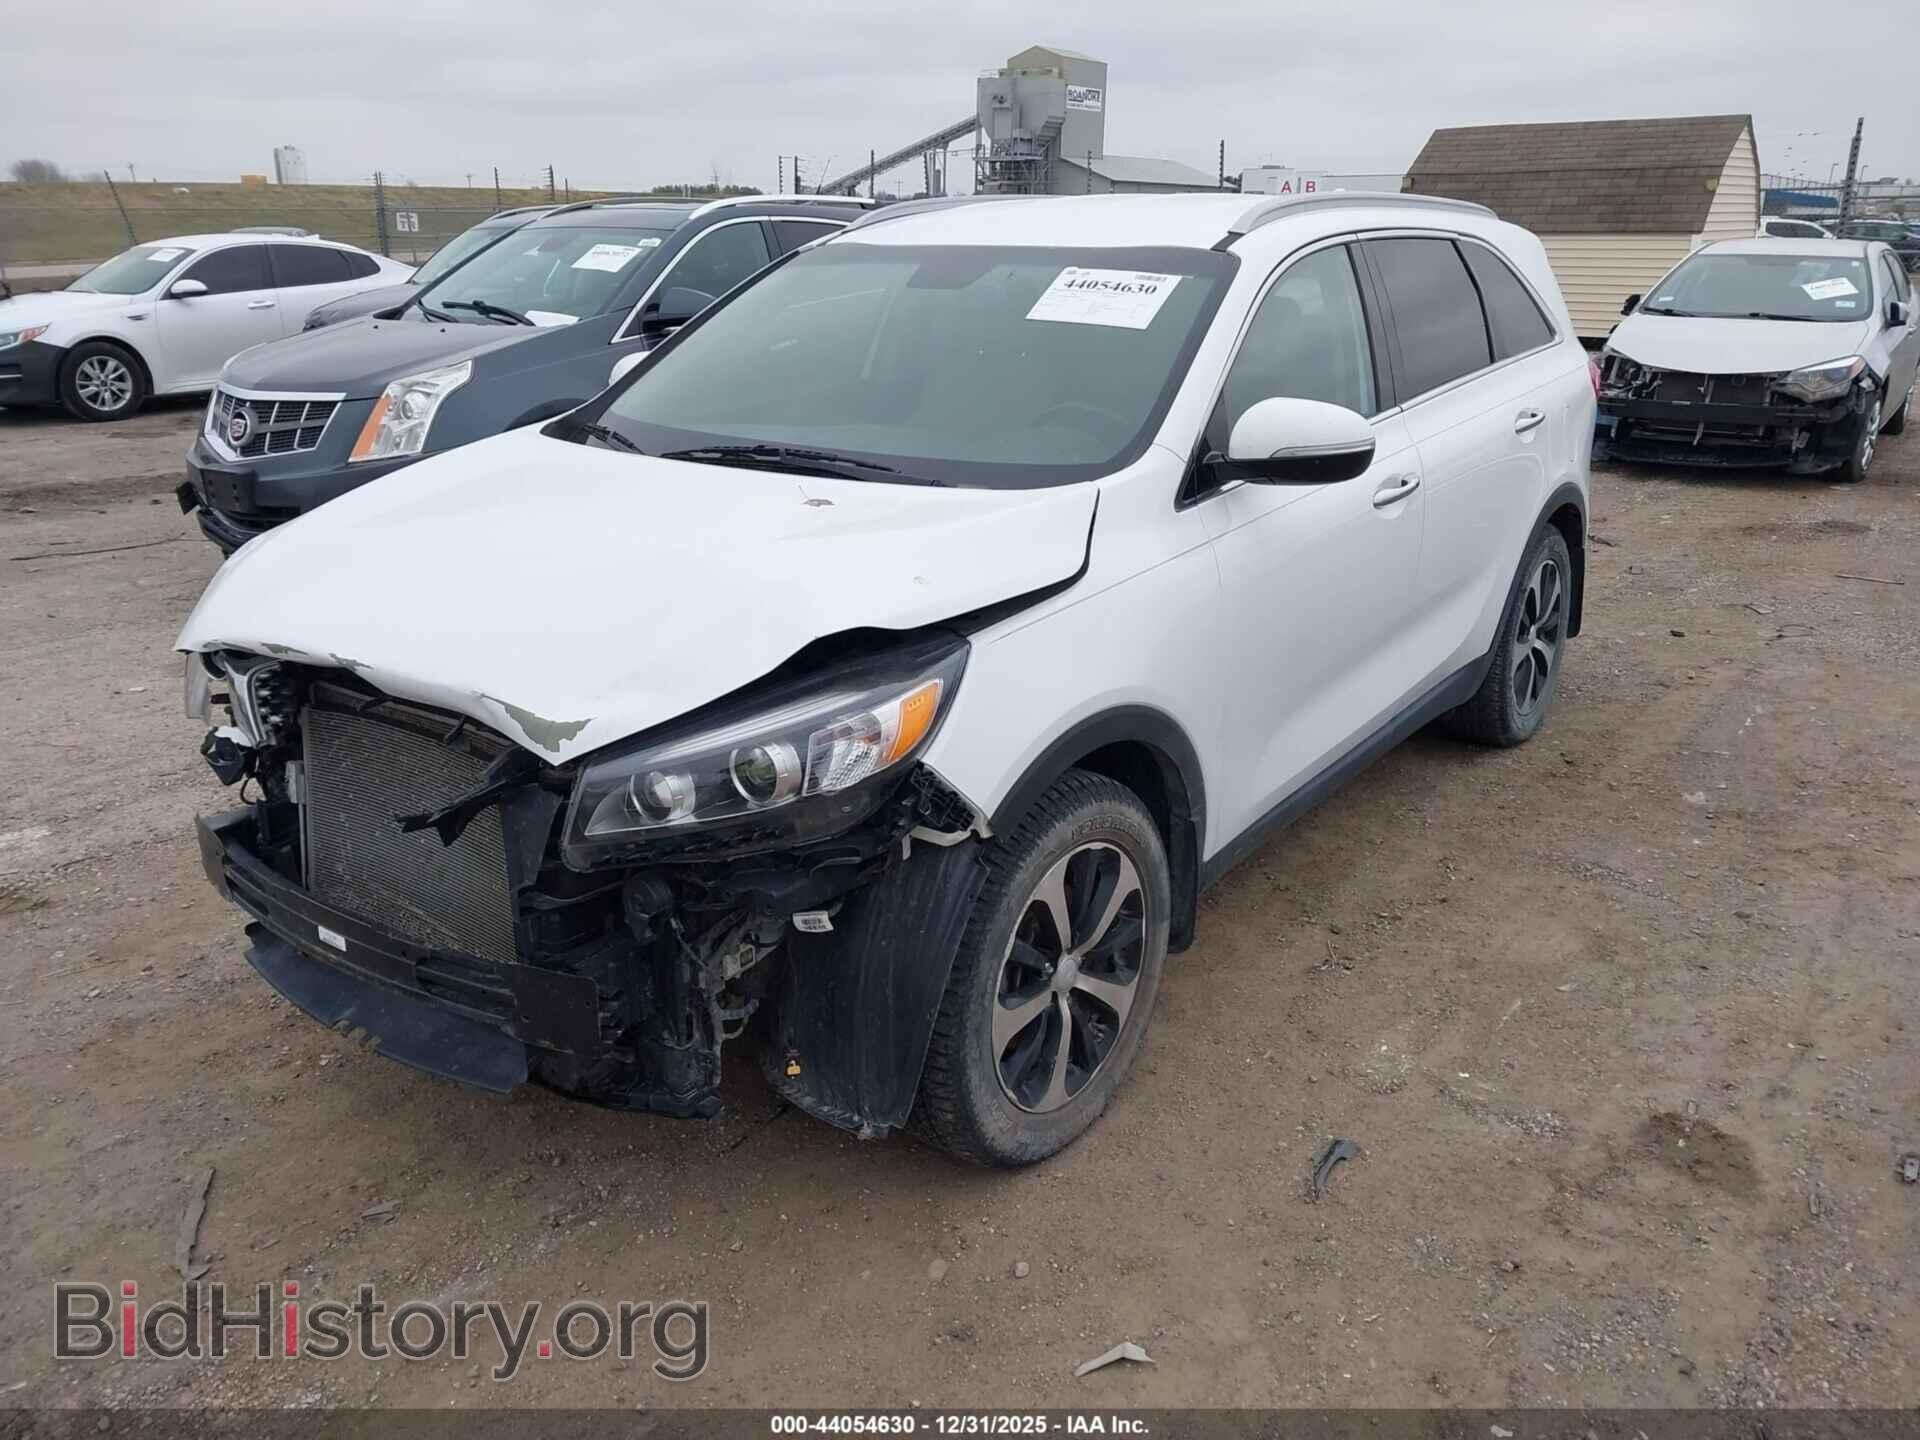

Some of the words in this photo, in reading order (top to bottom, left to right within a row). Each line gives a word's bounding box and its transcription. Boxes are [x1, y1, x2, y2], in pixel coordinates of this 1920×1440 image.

[1281, 181, 1292, 192] A
[1306, 181, 1316, 192] B
[1063, 278, 1158, 295] 44054630
